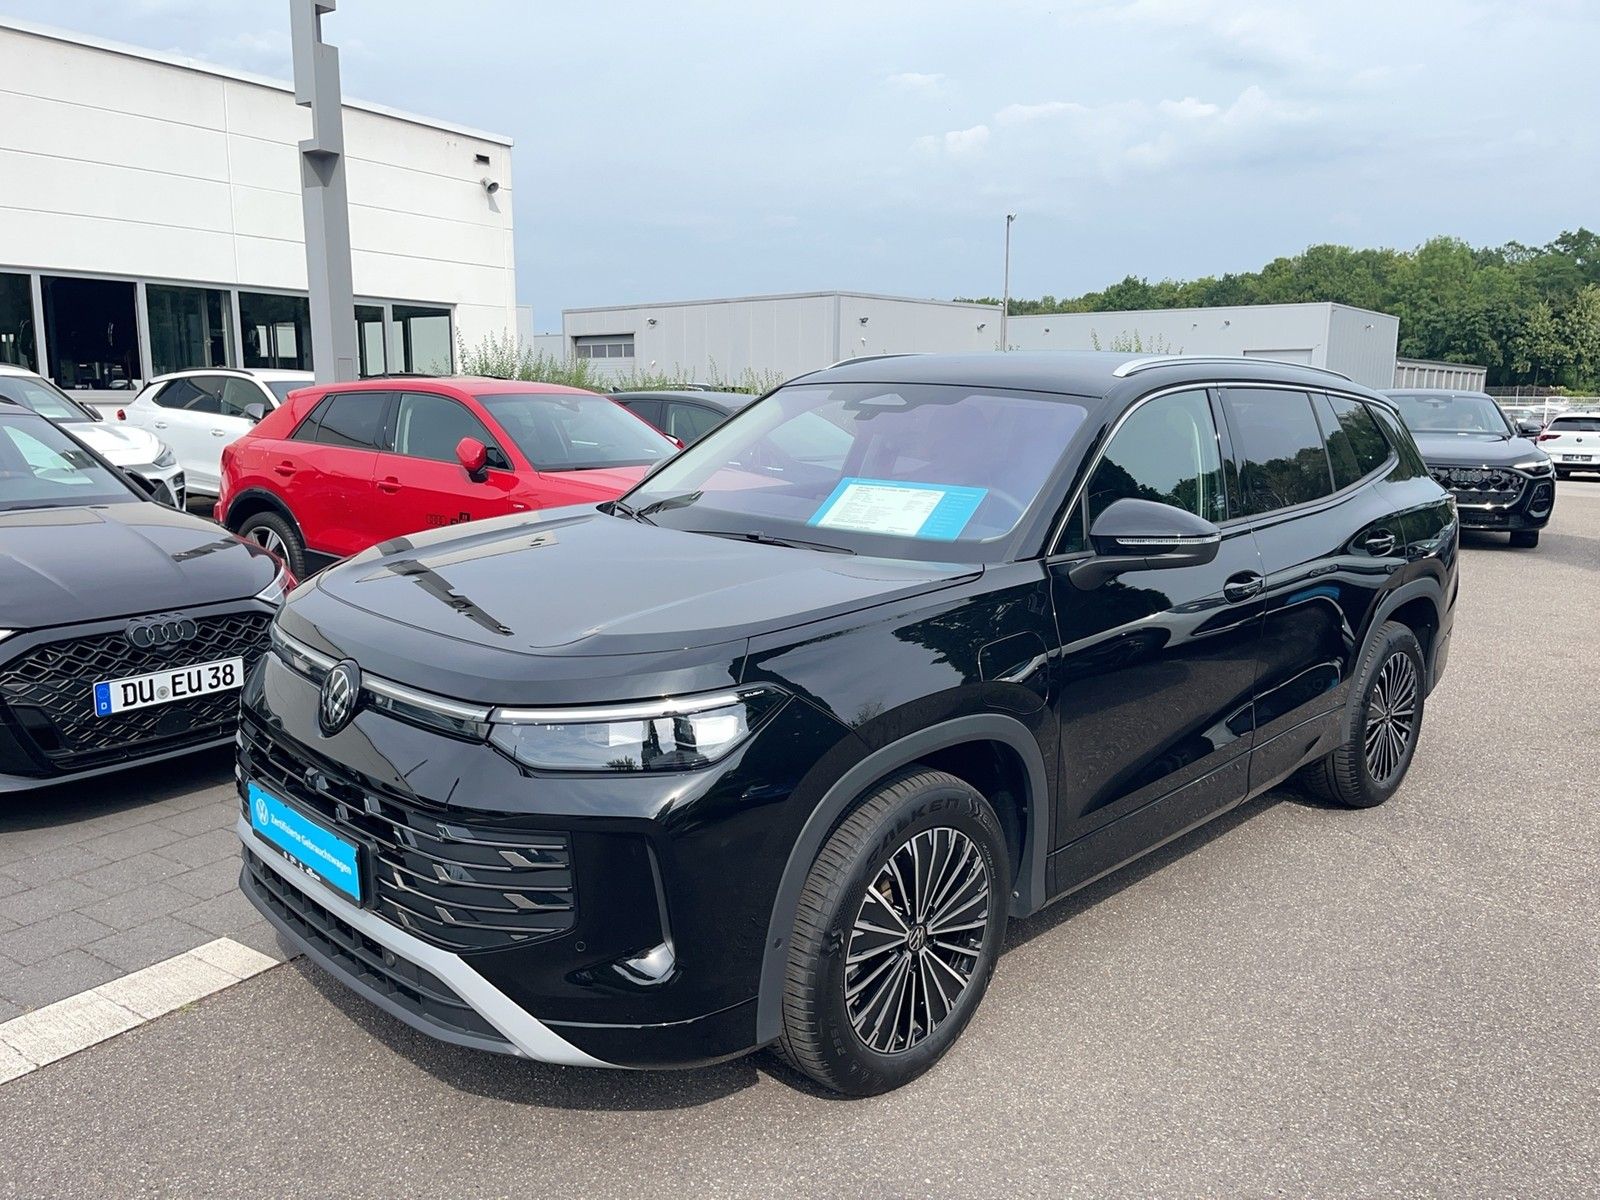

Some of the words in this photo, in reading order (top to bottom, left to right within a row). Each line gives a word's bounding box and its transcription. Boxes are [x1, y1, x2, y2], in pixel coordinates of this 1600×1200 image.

[121, 679, 155, 707] DU
[171, 670, 202, 697] EU
[208, 664, 235, 689] 38
